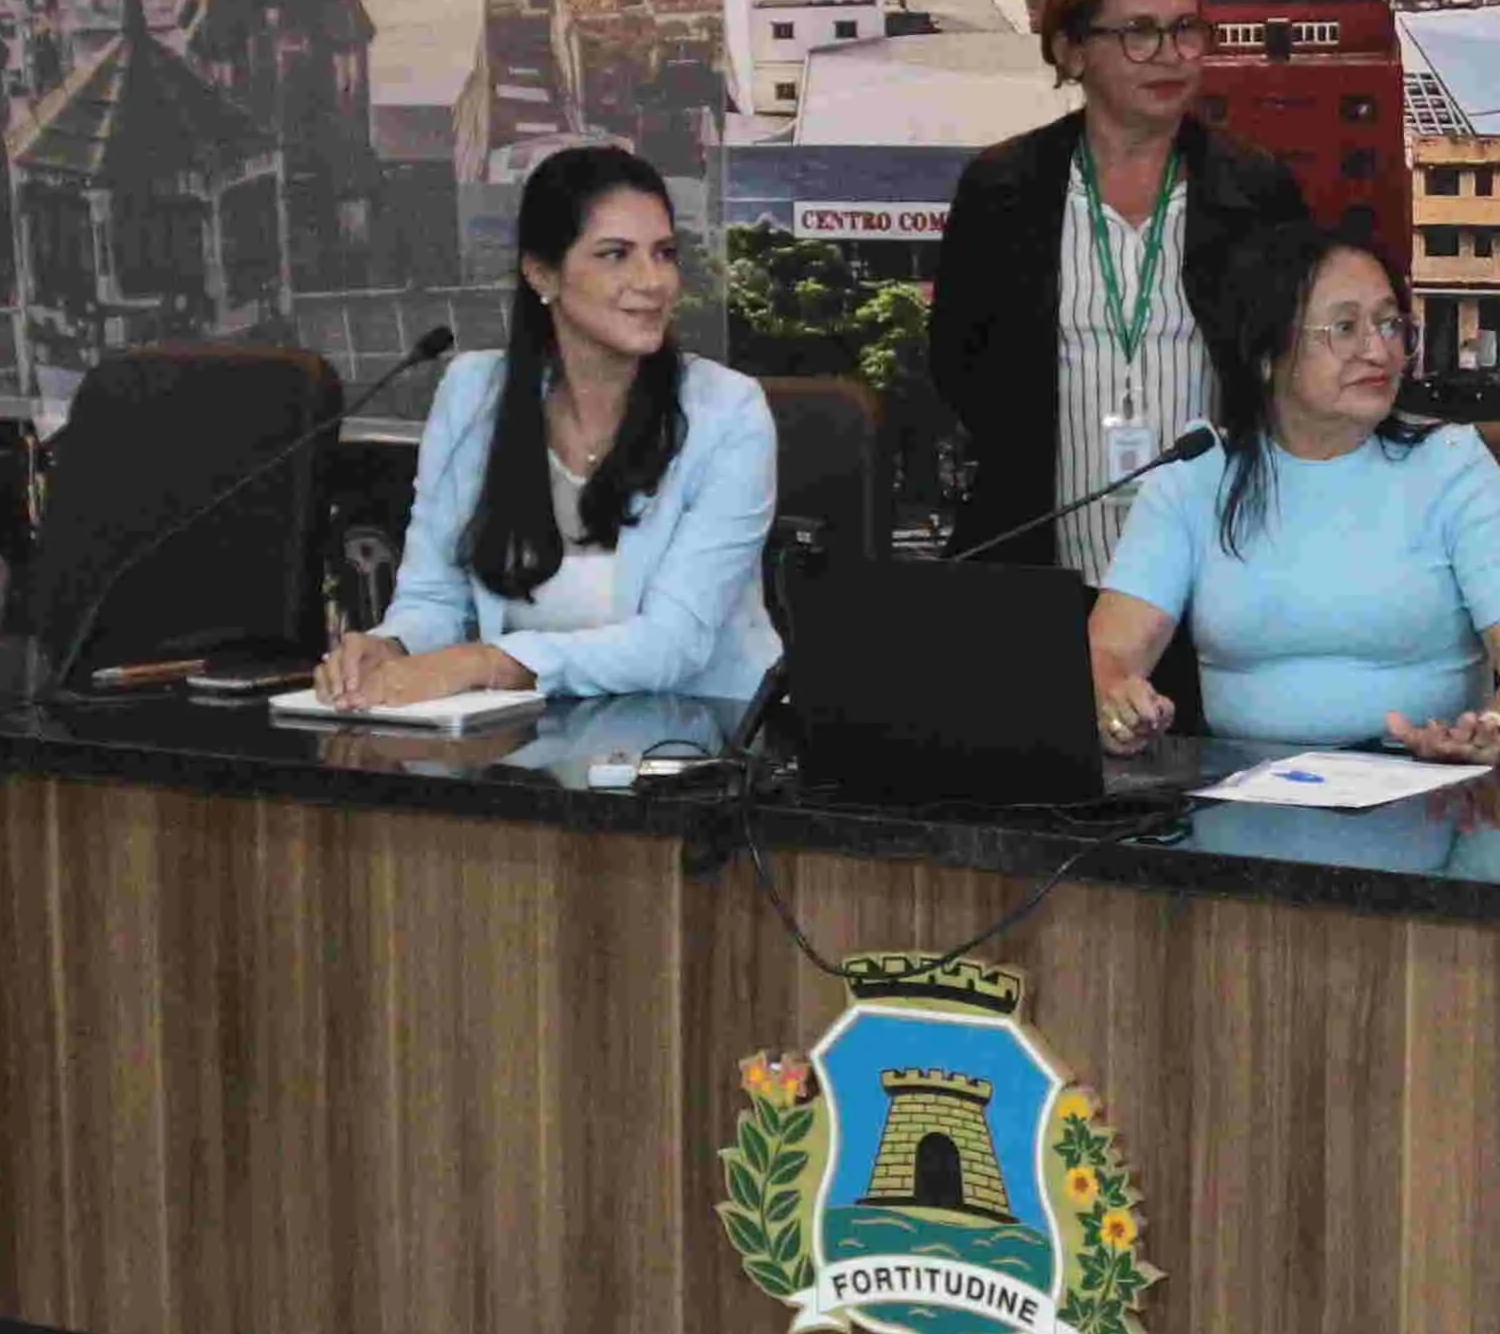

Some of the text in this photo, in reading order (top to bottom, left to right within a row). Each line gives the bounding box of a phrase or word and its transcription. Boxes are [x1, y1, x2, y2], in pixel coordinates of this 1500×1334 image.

[801, 209, 950, 232] CENTRO COM
[832, 1266, 1039, 1324] FORTITUDINE
